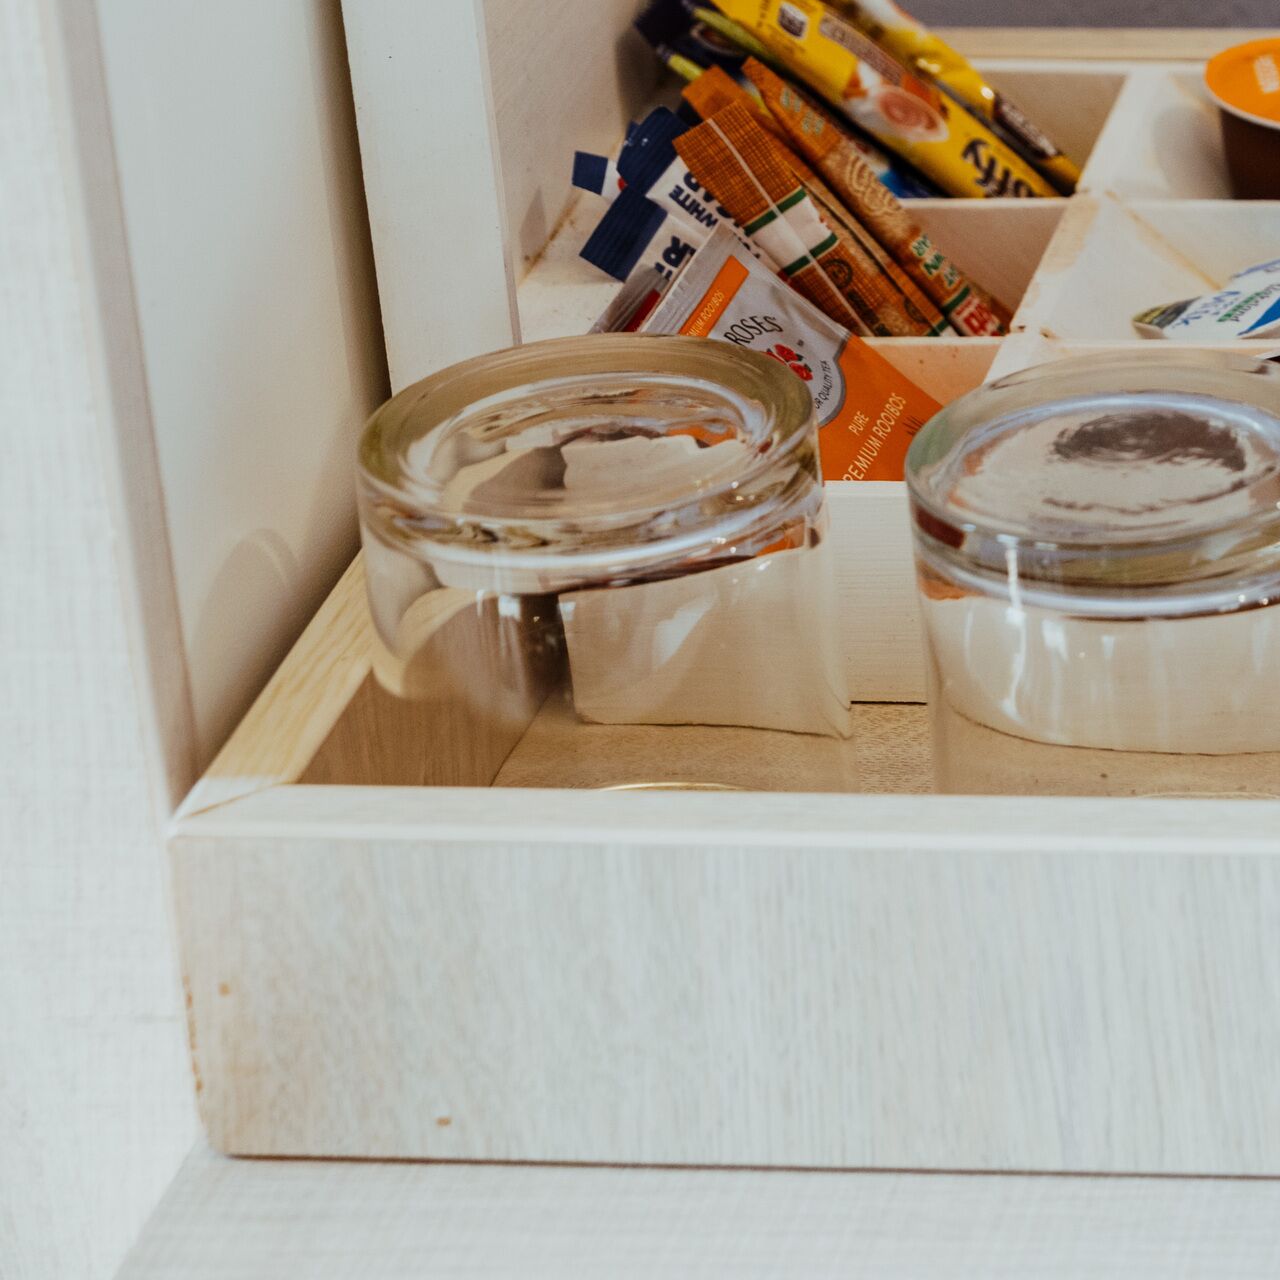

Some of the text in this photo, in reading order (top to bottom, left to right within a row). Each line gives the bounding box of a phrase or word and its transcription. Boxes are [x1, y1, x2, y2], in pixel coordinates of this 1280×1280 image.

[668, 184, 718, 228] WHITE
[723, 314, 784, 347] ROSES
[848, 410, 870, 436] PURE
[872, 392, 907, 440] ROOIBOS
